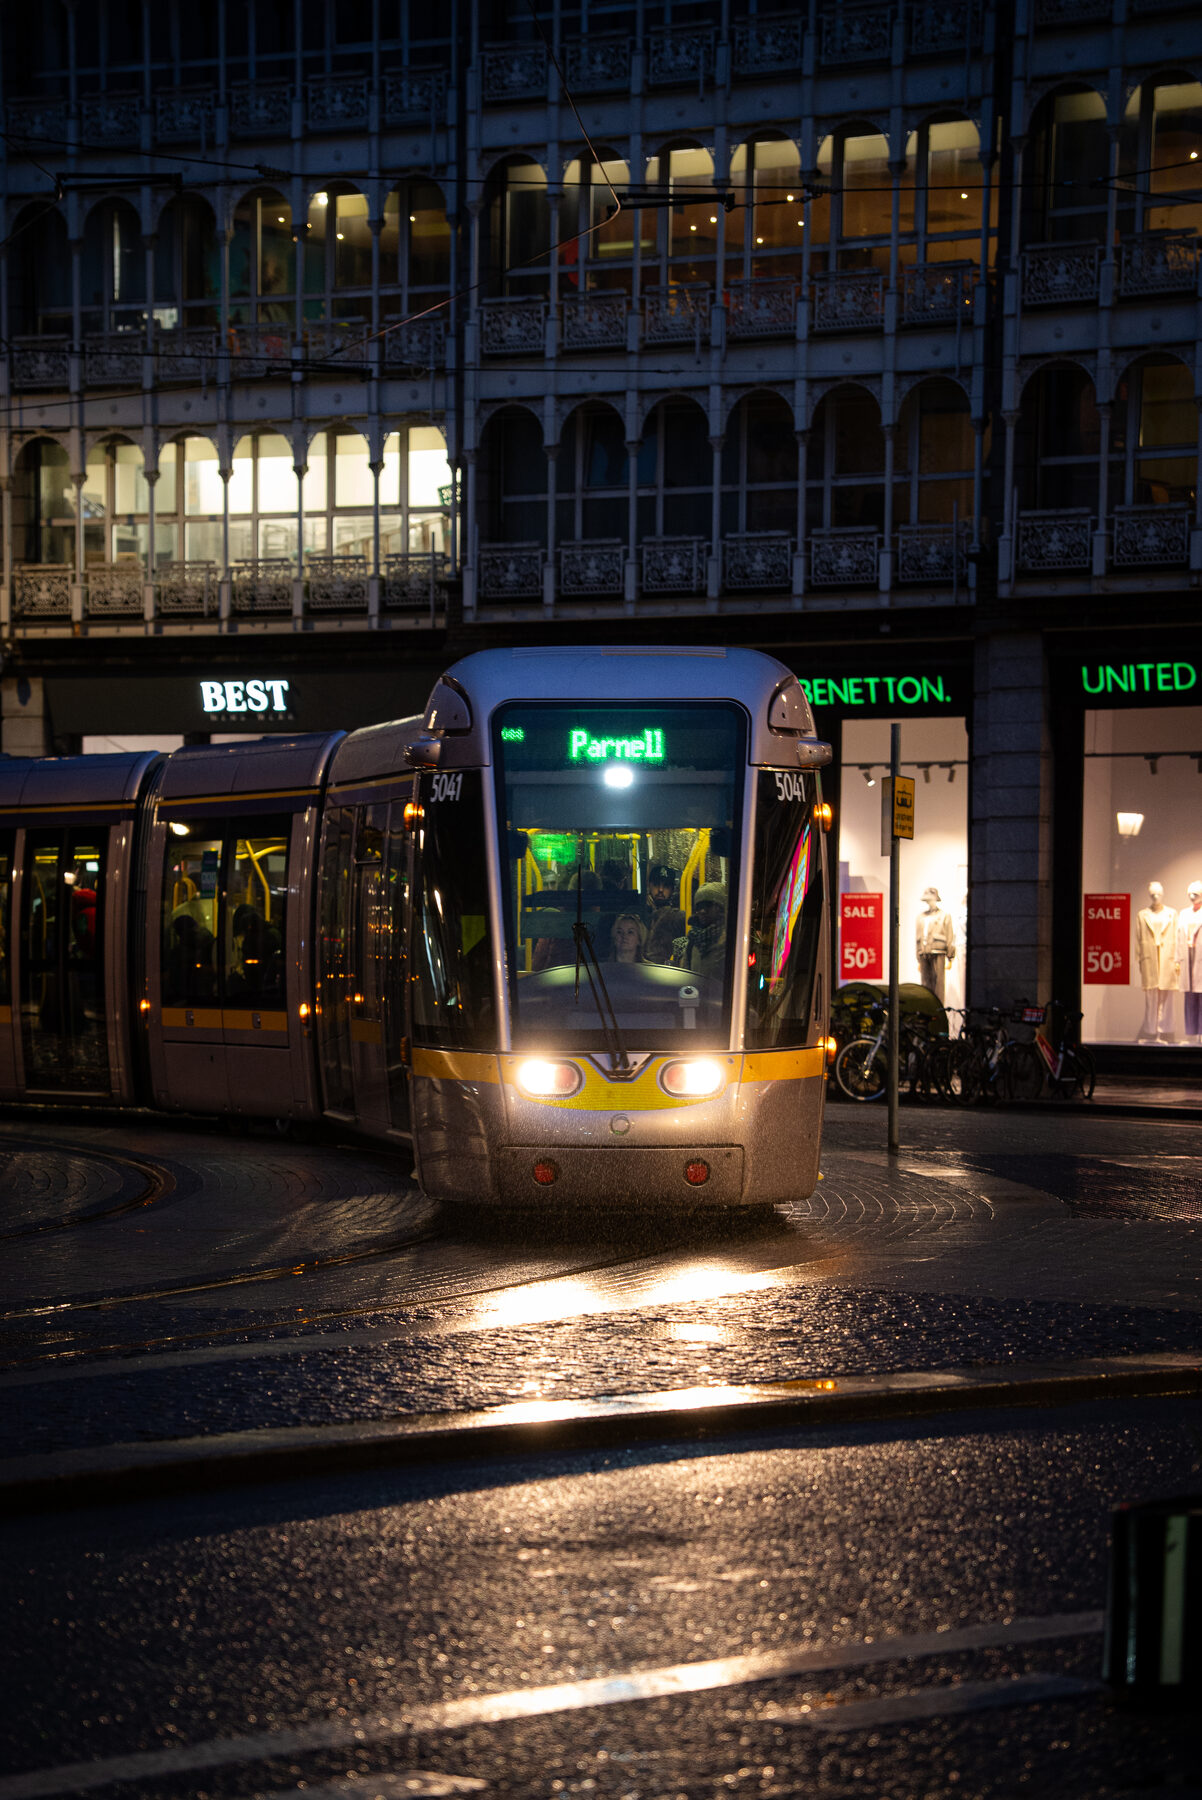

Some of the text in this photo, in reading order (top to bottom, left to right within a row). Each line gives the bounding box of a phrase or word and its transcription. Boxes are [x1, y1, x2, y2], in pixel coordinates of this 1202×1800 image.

[798, 675, 952, 706] BENETTON.
[1082, 662, 1197, 694] UNITED
[200, 679, 290, 712] BEST
[569, 727, 664, 760] Parnell
[430, 773, 463, 802] 5041
[775, 772, 806, 802] 5041
[843, 906, 875, 918] SALE
[1087, 907, 1121, 920] SALE
